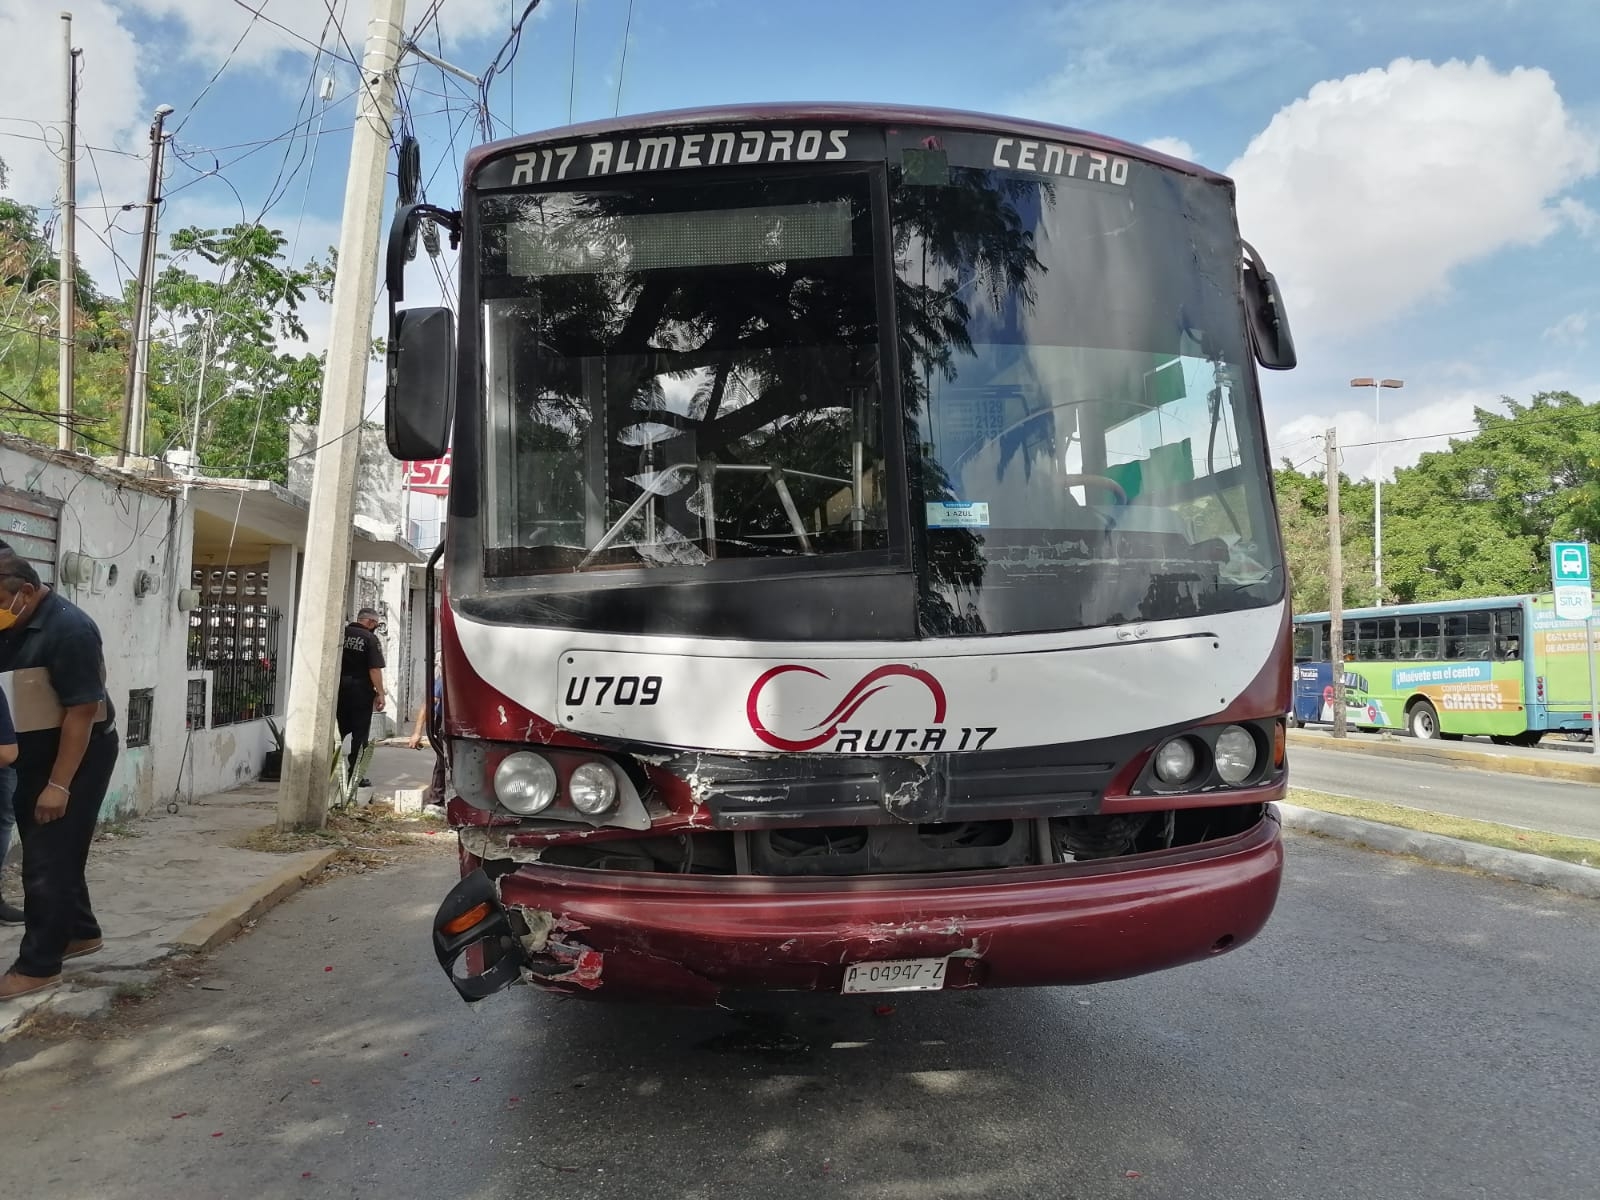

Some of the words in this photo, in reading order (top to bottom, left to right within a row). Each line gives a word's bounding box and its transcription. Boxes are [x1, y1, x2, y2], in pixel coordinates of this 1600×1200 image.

[511, 147, 578, 185] R17
[587, 129, 849, 176] ALMENDROS
[992, 137, 1129, 186] CENTRO
[1432, 670, 1442, 680] en
[1444, 667, 1451, 679] el
[1452, 666, 1480, 678] centro
[565, 675, 663, 706] U709
[1441, 683, 1499, 694] completamente
[1442, 693, 1503, 710] GRATIS!
[957, 727, 998, 751] 17
[848, 962, 944, 982] A-04947-Z
